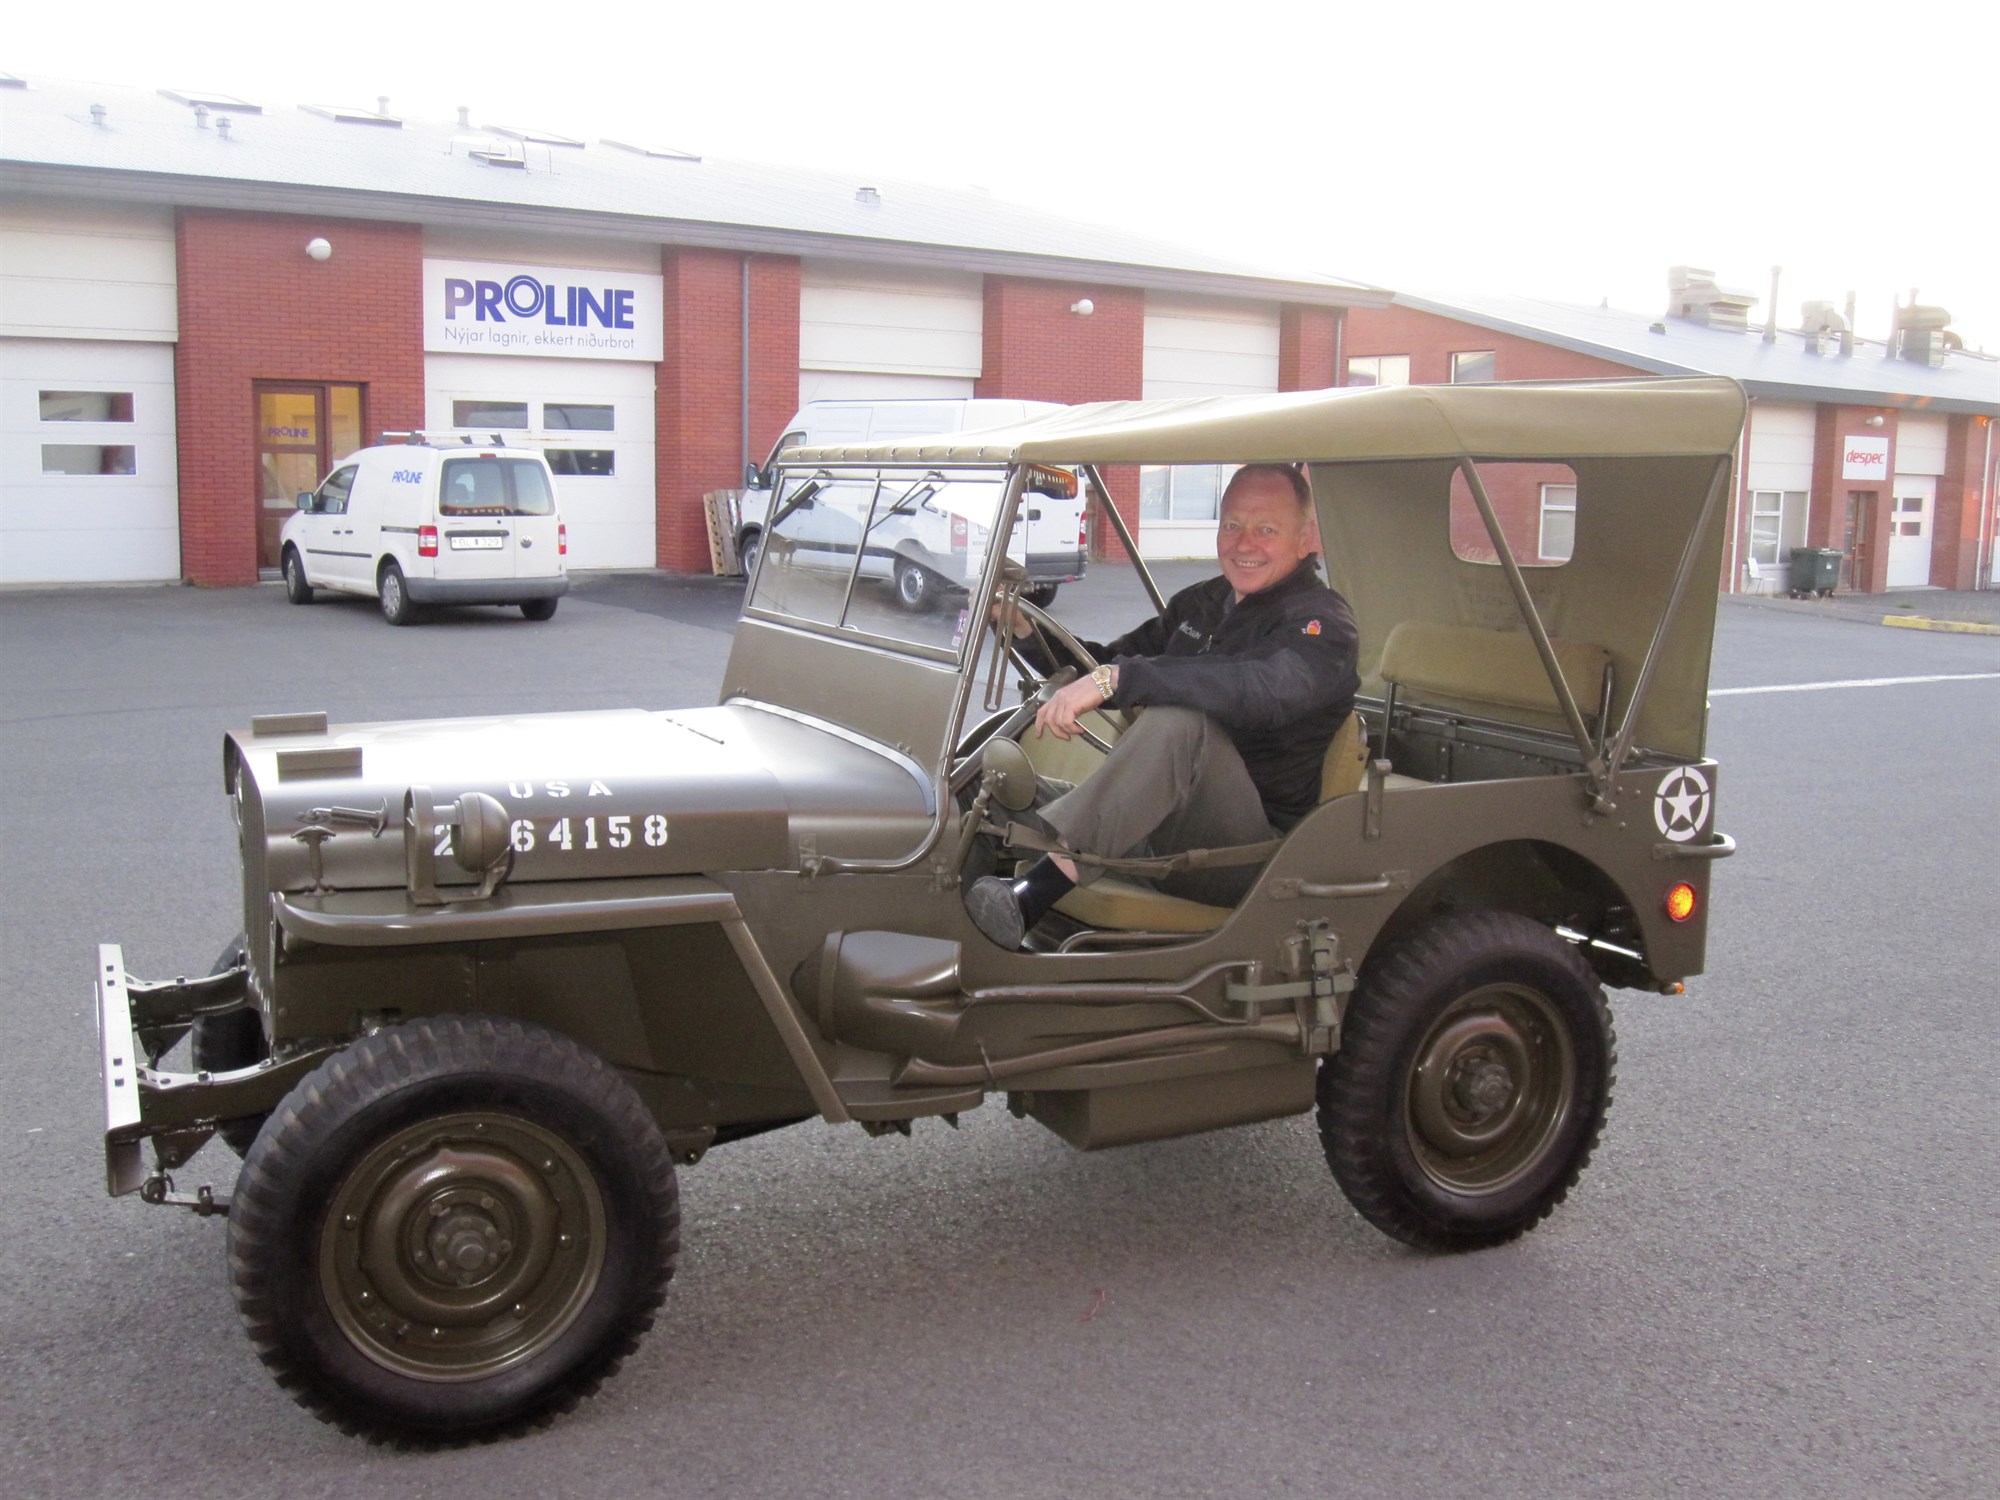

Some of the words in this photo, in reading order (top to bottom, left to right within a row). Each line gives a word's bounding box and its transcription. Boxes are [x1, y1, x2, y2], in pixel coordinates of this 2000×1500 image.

[445, 274, 635, 330] PROLINE
[445, 328, 485, 346] Nýjar
[488, 329, 530, 347] lagnir,
[534, 331, 573, 346] ekkert
[577, 333, 635, 349] niðurbrot
[268, 426, 309, 437] PROLINE
[1846, 450, 1885, 466] despec
[392, 469, 422, 483] PROLINE
[508, 780, 613, 799] USA
